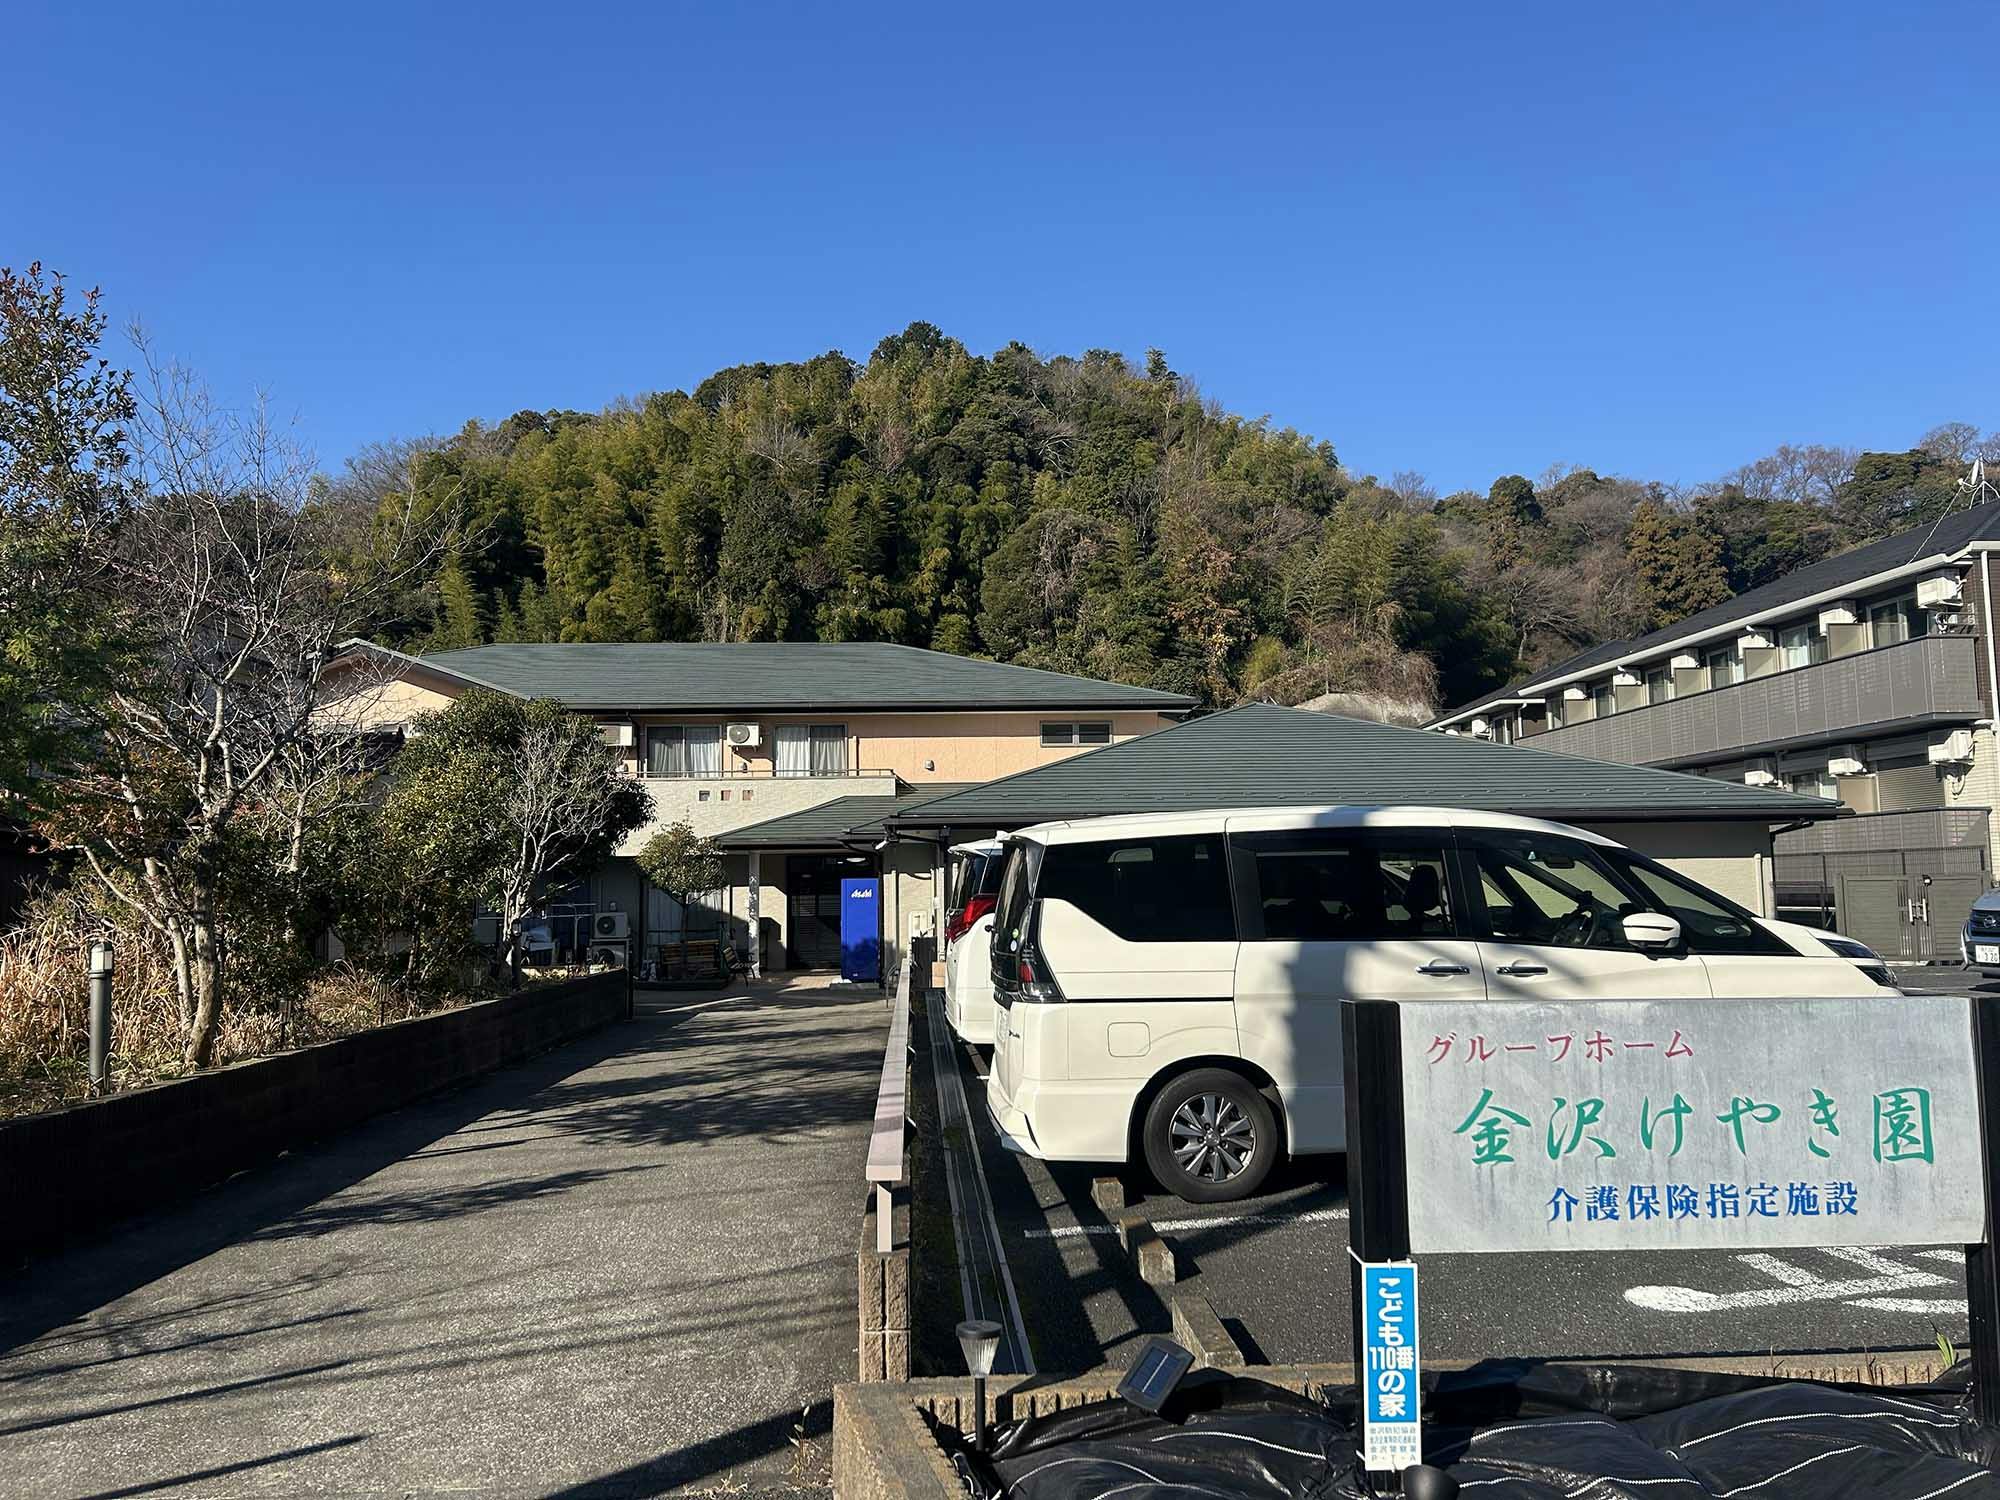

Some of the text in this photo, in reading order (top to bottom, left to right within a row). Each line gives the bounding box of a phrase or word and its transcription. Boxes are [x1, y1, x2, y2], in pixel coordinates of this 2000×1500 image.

[1426, 1031, 1695, 1065] グループホーム
[1455, 1087, 1936, 1166] 金沢けやき園
[1546, 1181, 1859, 1223] 介護保険指定施設
